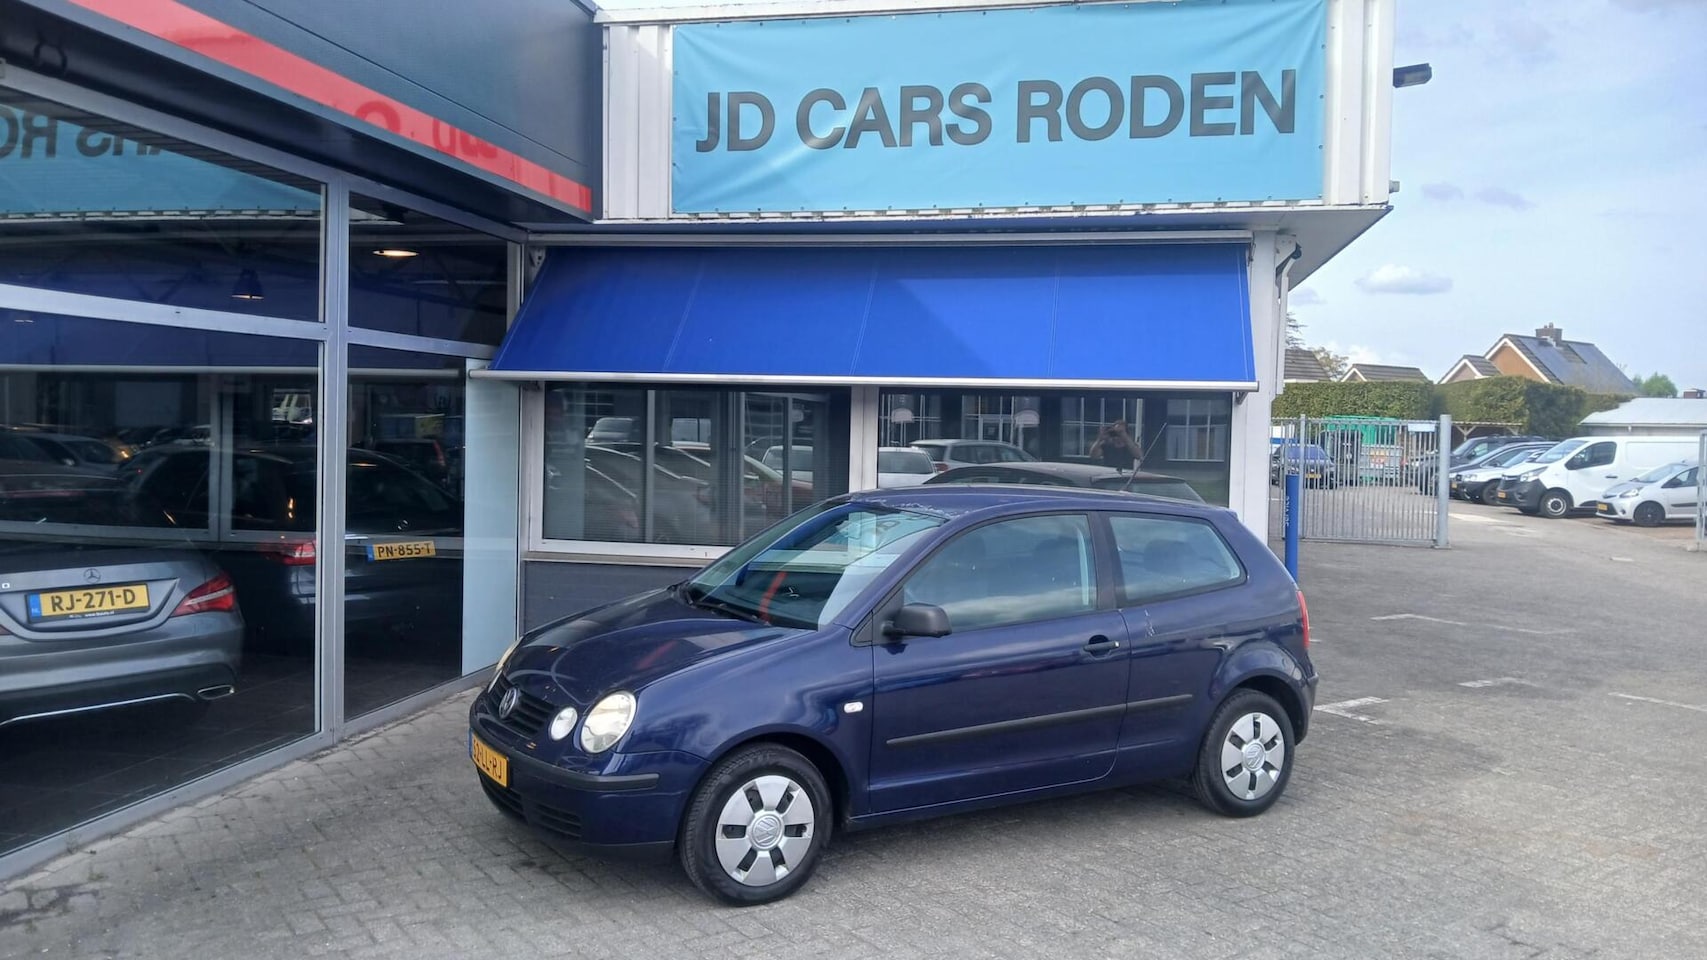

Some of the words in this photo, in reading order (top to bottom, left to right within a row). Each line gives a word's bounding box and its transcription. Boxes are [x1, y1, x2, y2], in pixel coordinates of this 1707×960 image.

[696, 91, 776, 153] JD
[796, 82, 993, 150] CARS
[1016, 69, 1296, 143] RODEN
[377, 543, 432, 558] PN-855-T
[51, 588, 136, 612] RJ-271-D
